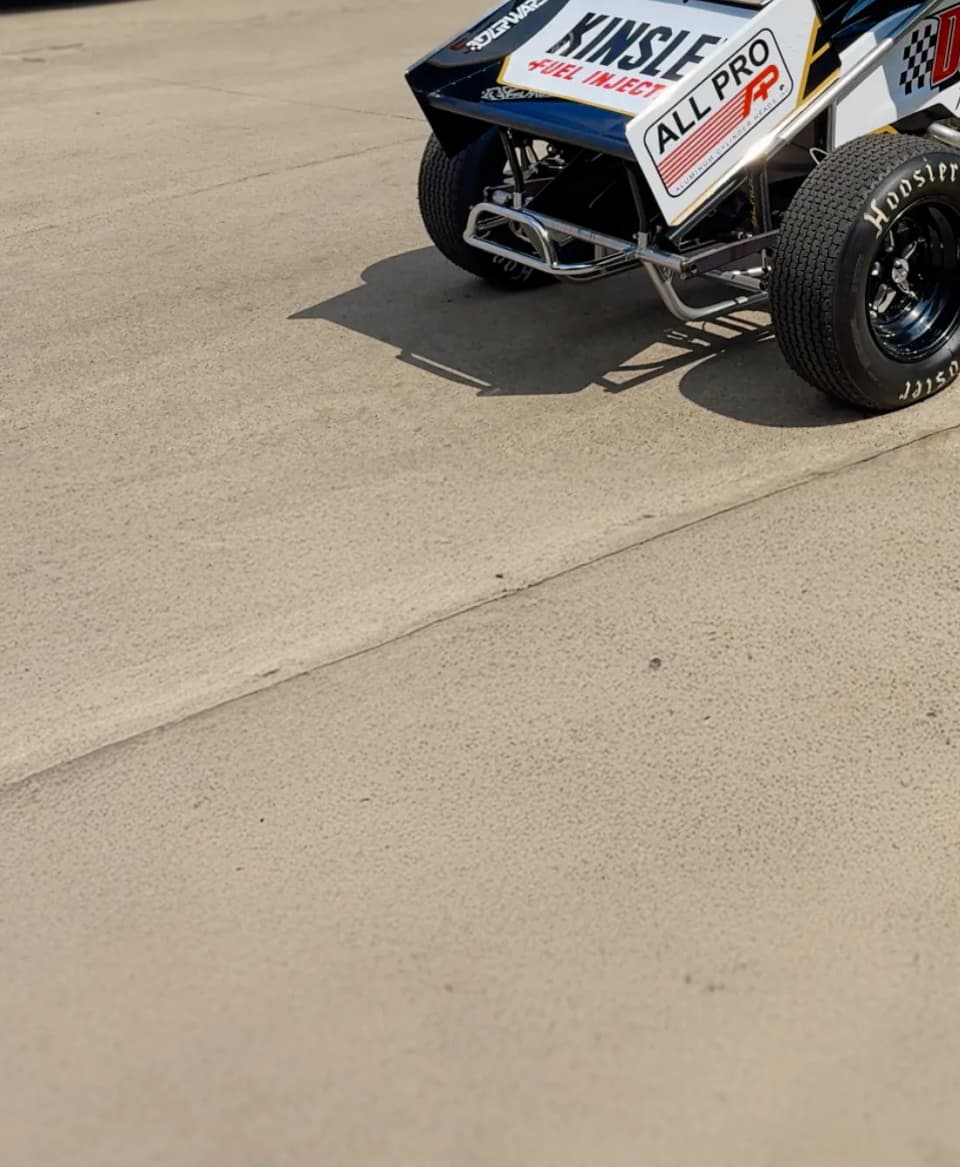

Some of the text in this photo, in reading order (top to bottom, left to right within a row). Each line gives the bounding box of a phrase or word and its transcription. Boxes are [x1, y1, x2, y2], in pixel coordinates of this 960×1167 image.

[528, 58, 583, 81] FUEL
[545, 12, 728, 82] KINSLE
[659, 38, 769, 154] ALL PRO
[864, 161, 959, 237] Hoosier
